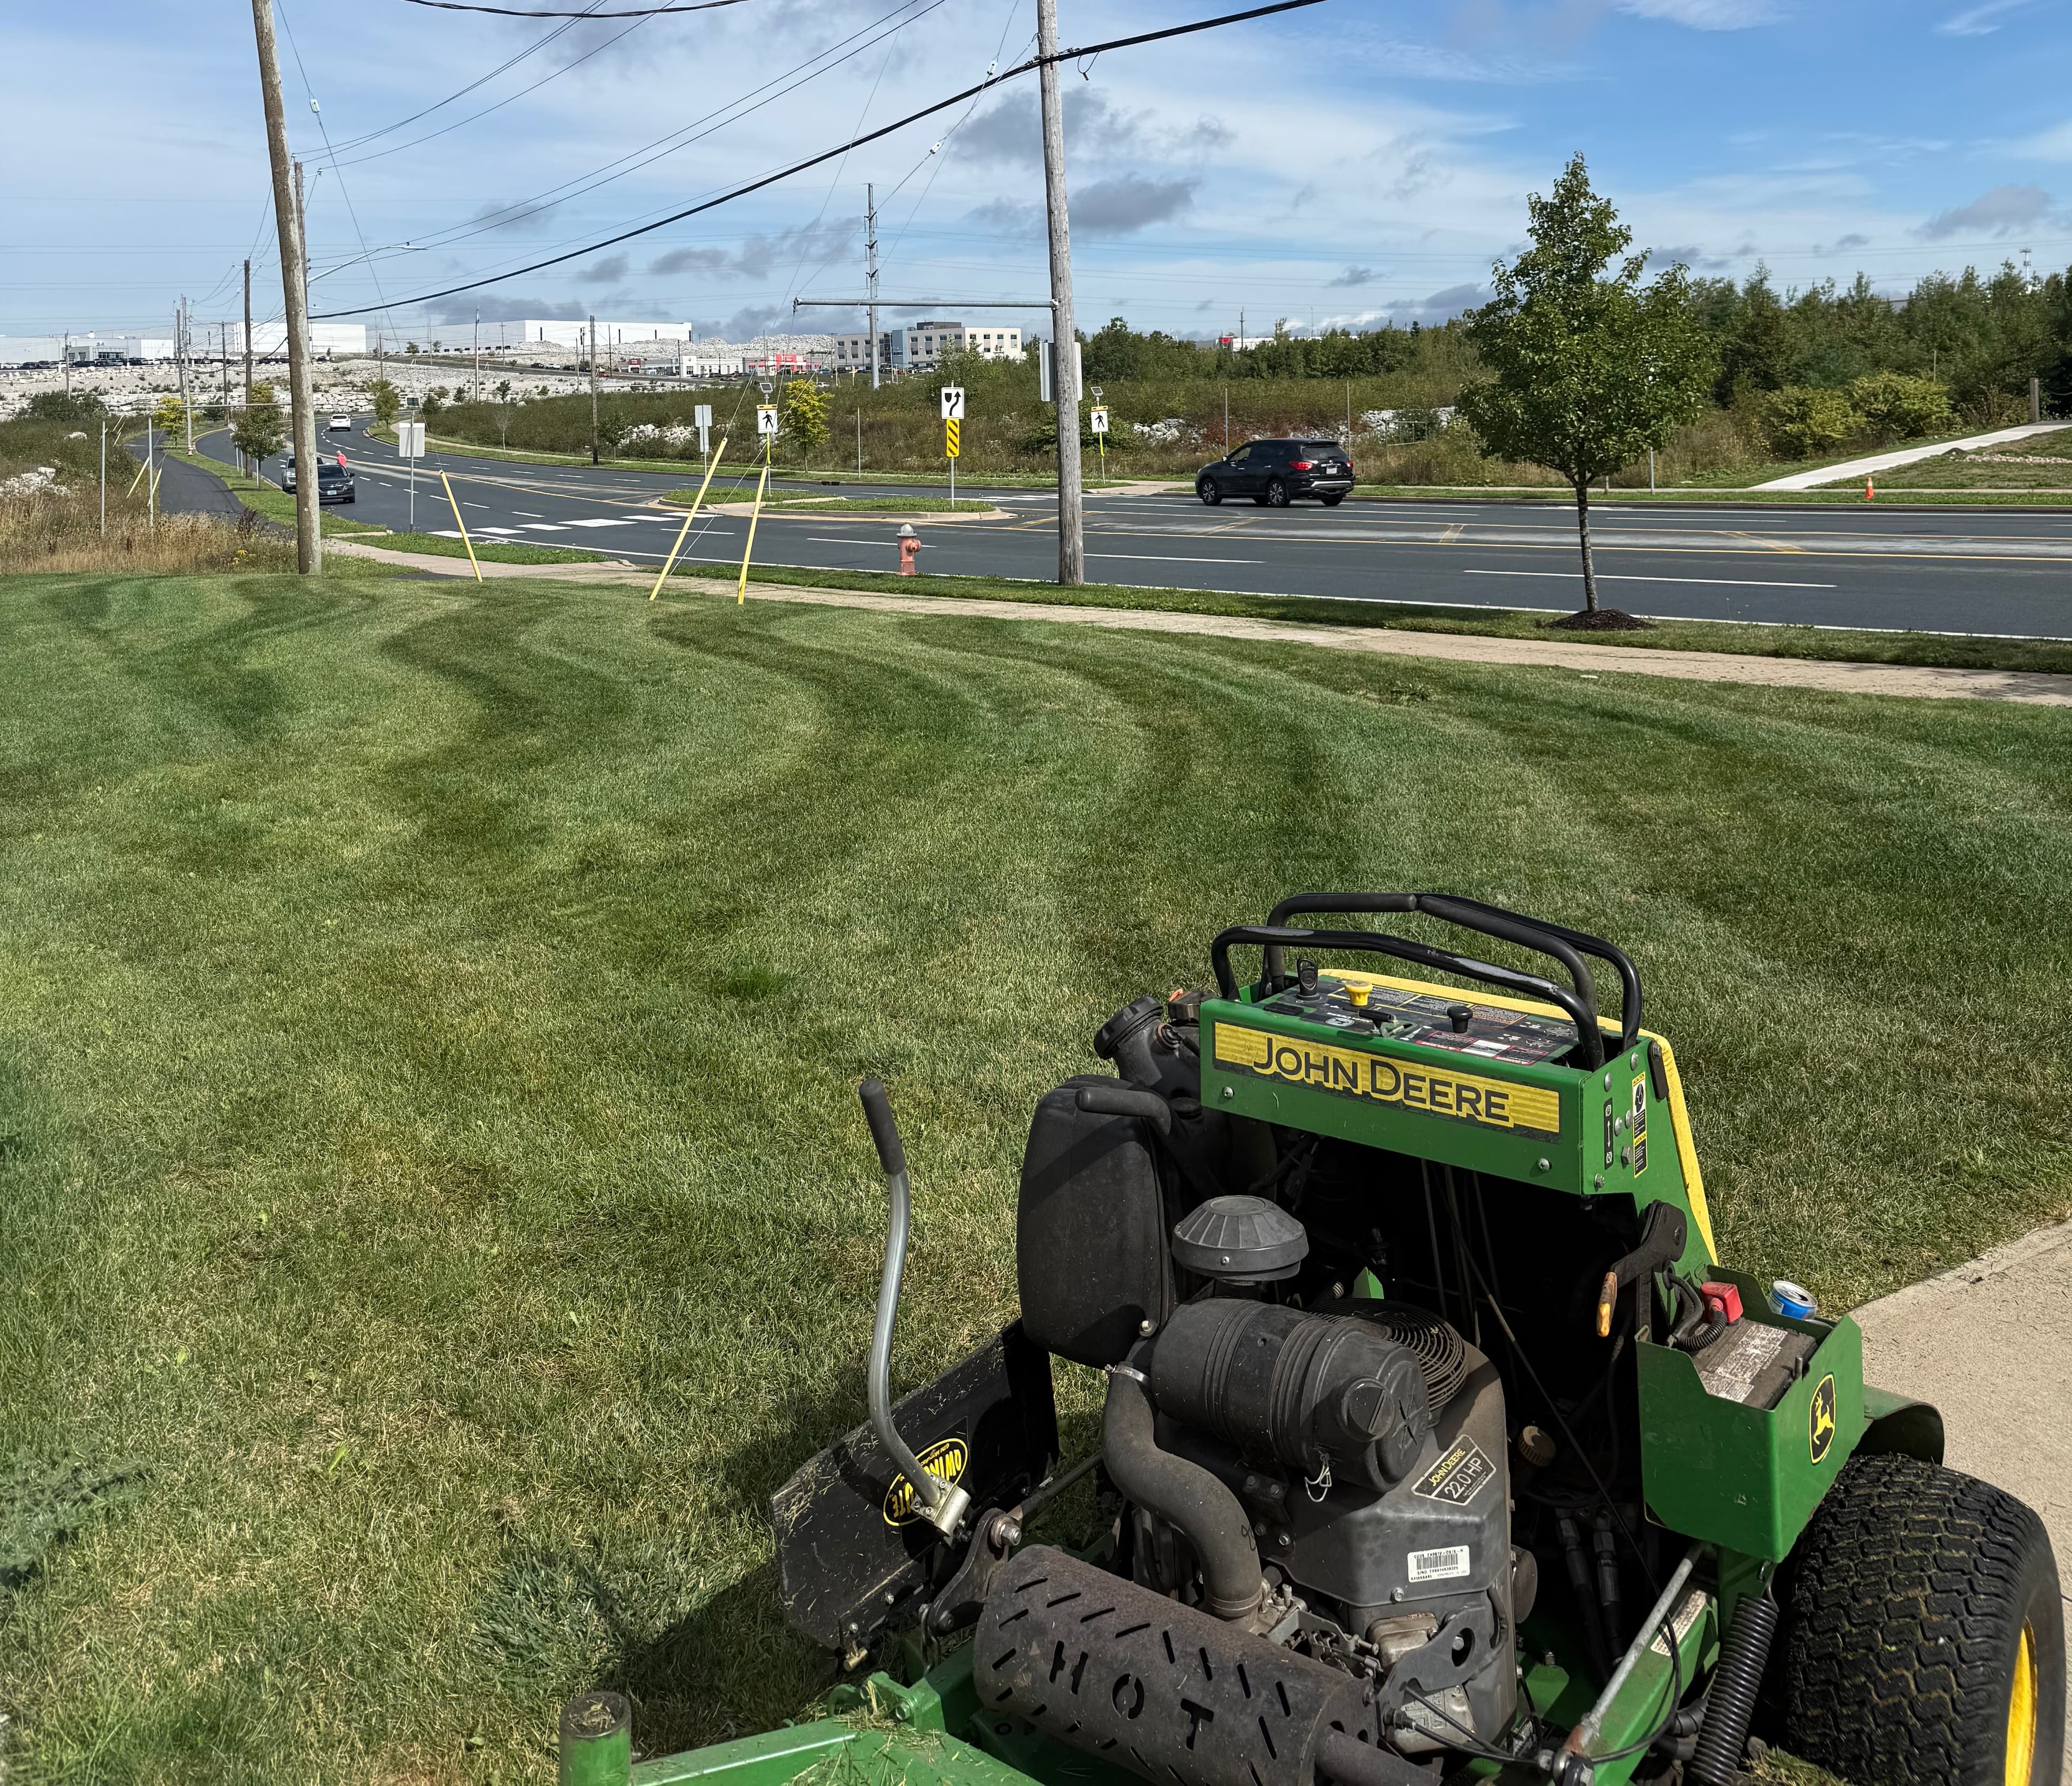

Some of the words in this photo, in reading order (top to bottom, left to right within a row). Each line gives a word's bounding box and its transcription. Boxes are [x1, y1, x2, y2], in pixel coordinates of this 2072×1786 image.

[1252, 1036, 1360, 1091] JOHN
[1369, 1058, 1512, 1123] DEERE
[1428, 1462, 1449, 1487] JOHN
[1443, 1448, 1466, 1475] DEERE
[1444, 1473, 1471, 1499] 22.0
[1467, 1457, 1484, 1477] HP
[1048, 1639, 1215, 1751] HOT
